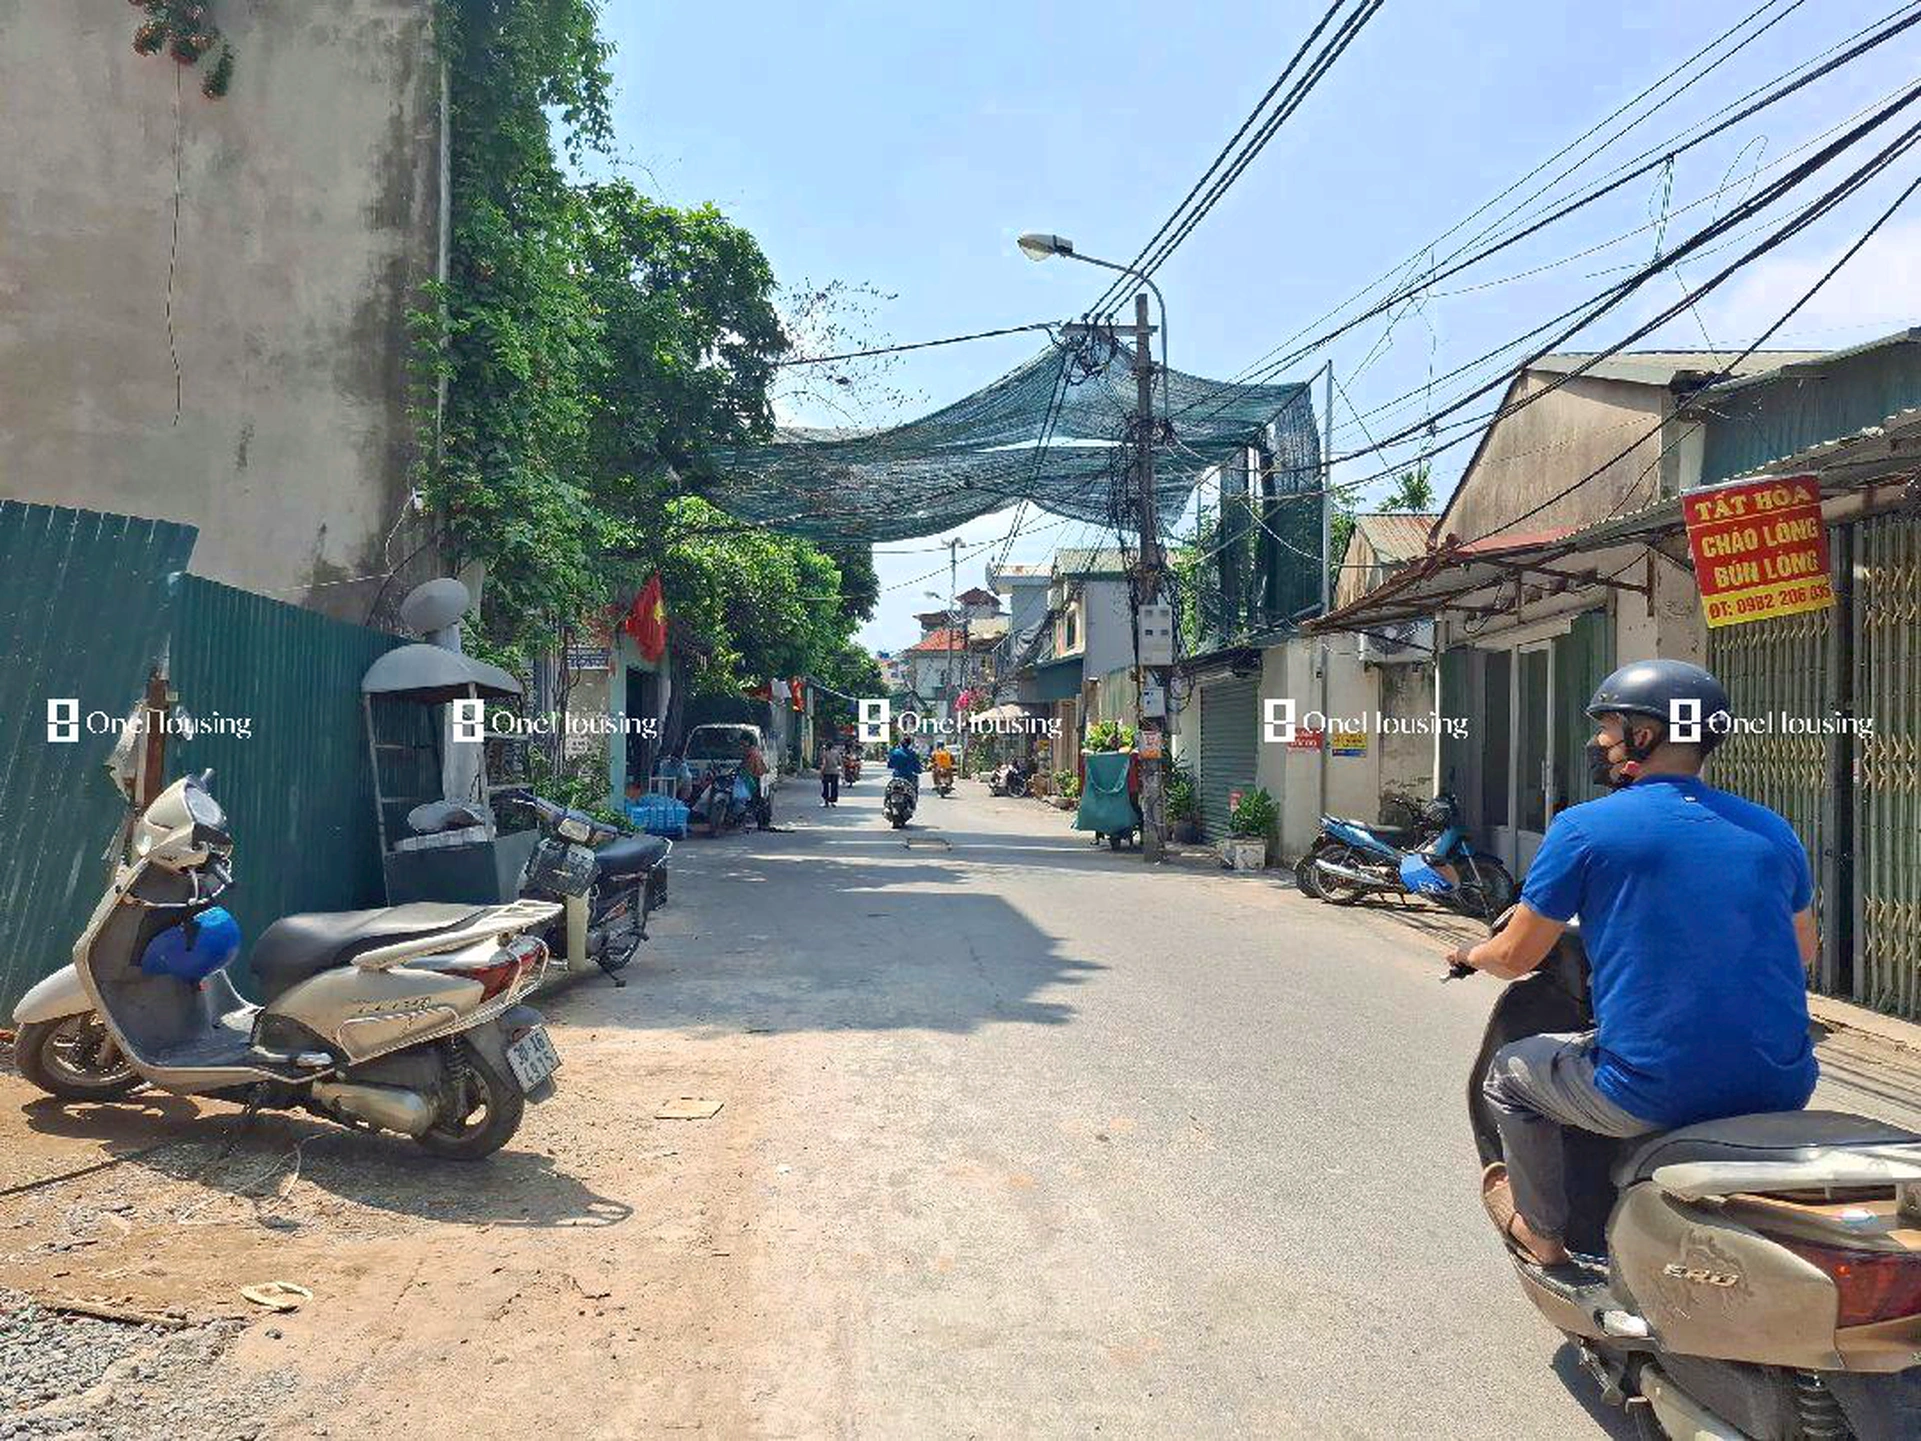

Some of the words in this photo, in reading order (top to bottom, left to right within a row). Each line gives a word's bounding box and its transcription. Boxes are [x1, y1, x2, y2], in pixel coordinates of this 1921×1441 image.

[1702, 526, 1758, 558] CHÁO
[1763, 518, 1819, 547] LÒNG
[1714, 560, 1760, 588] BÚN
[1763, 550, 1820, 579] LÒNG
